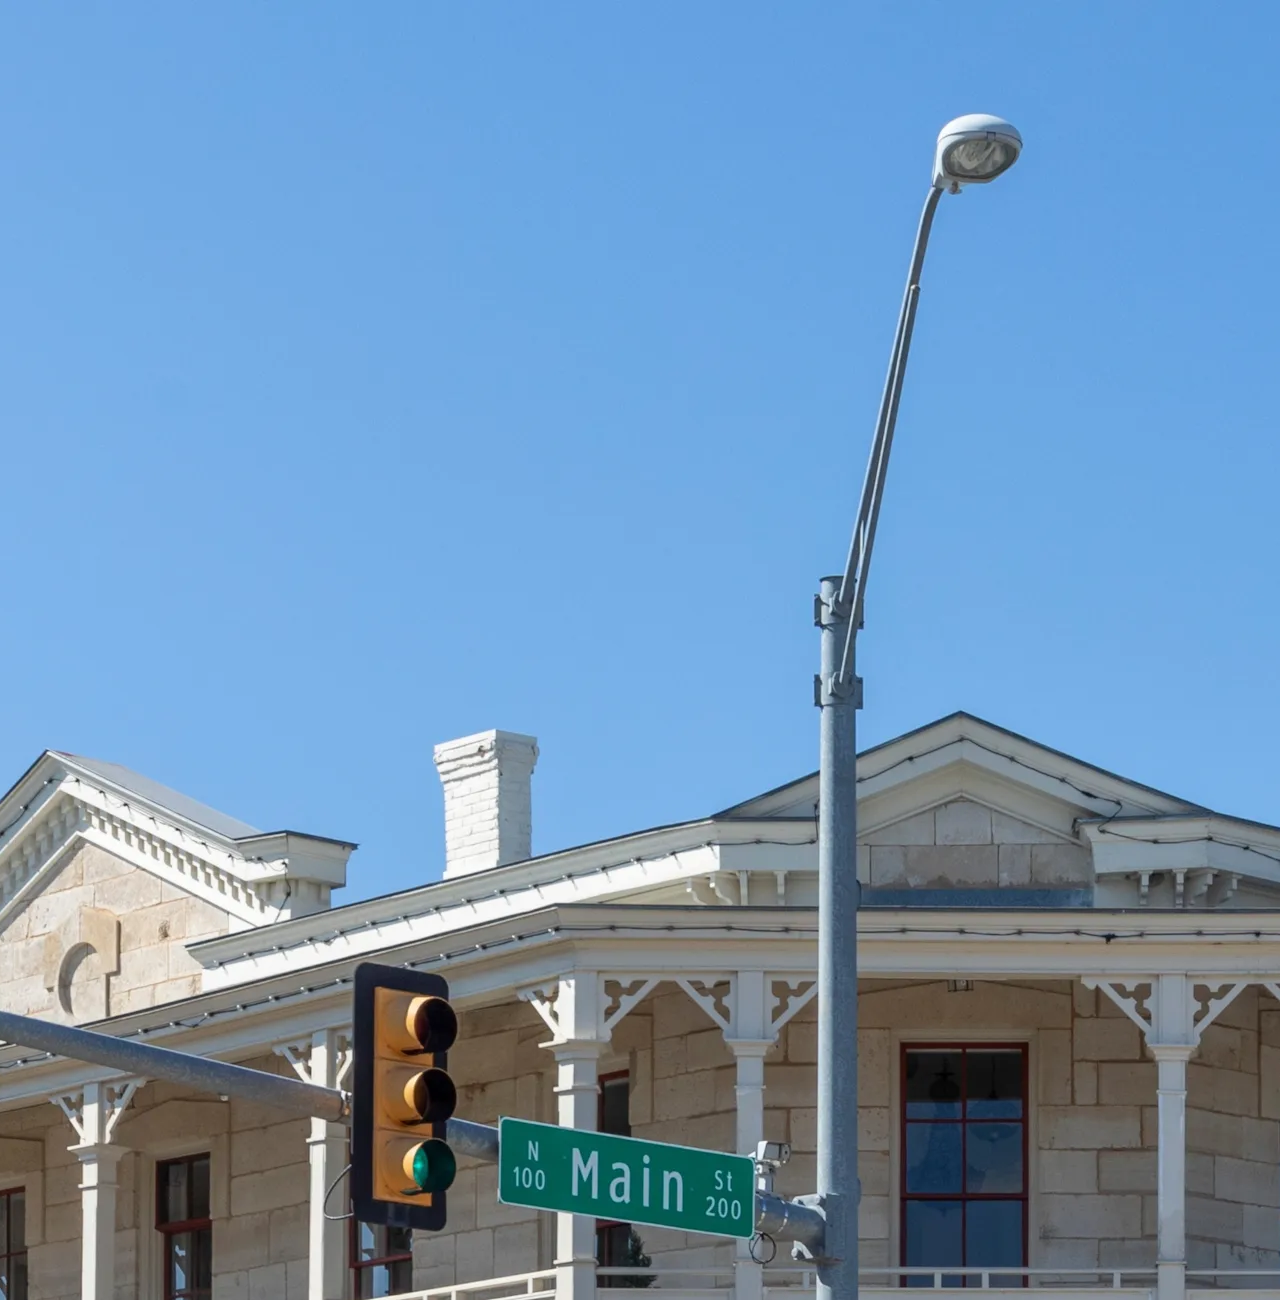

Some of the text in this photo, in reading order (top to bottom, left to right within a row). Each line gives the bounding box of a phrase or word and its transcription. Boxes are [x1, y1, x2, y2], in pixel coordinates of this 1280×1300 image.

[513, 1165, 546, 1191] 100
[527, 1140, 733, 1213] N Main St
[705, 1196, 742, 1220] 200
